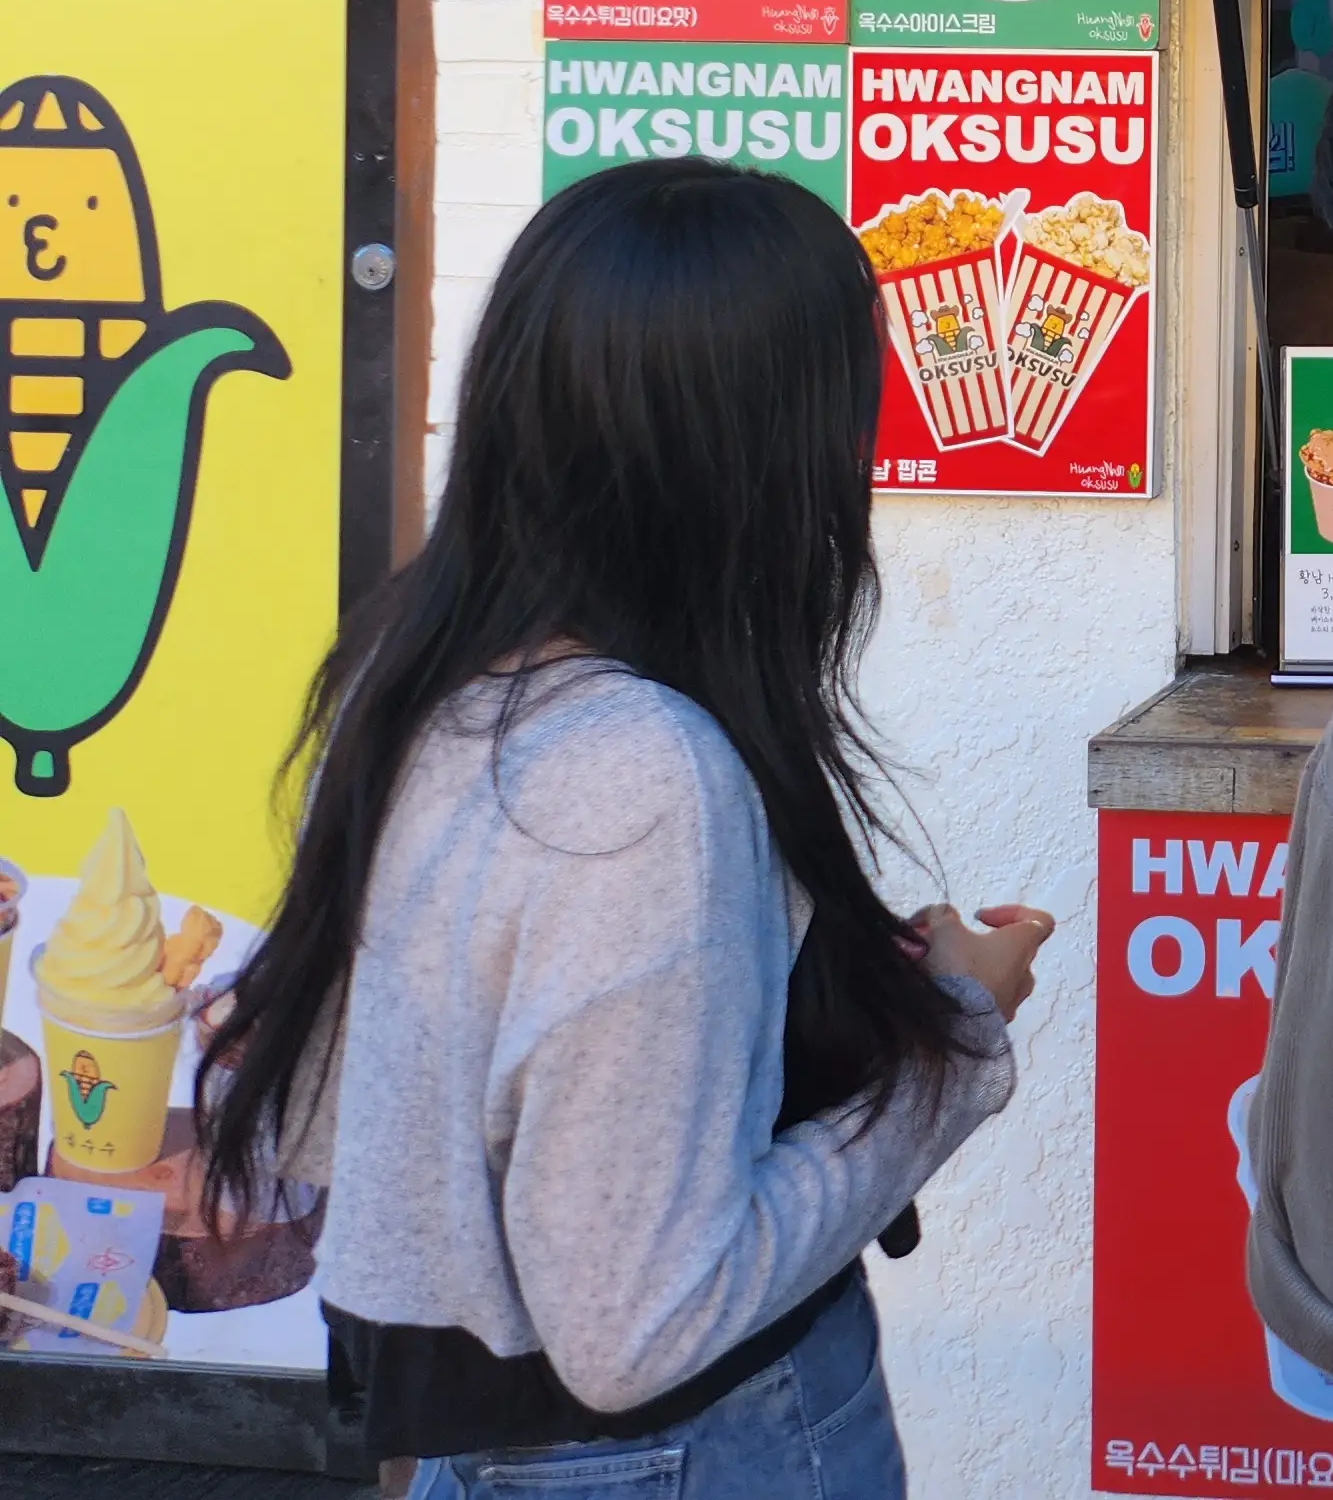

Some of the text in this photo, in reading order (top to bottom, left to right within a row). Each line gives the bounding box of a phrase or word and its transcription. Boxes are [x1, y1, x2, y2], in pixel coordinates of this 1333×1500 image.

[546, 5, 698, 27] 옥수수튀김(마요맛)
[858, 12, 996, 34] 옥수수아이스크림
[549, 60, 843, 99] HWANGNAM
[861, 68, 1145, 106] HWANGNAM
[546, 106, 842, 161] OKSUSU
[858, 113, 1145, 165] OKSUSU
[919, 352, 998, 382] OKSUSU
[872, 458, 938, 483] 남 팝콘
[1299, 569, 1323, 584] 황남
